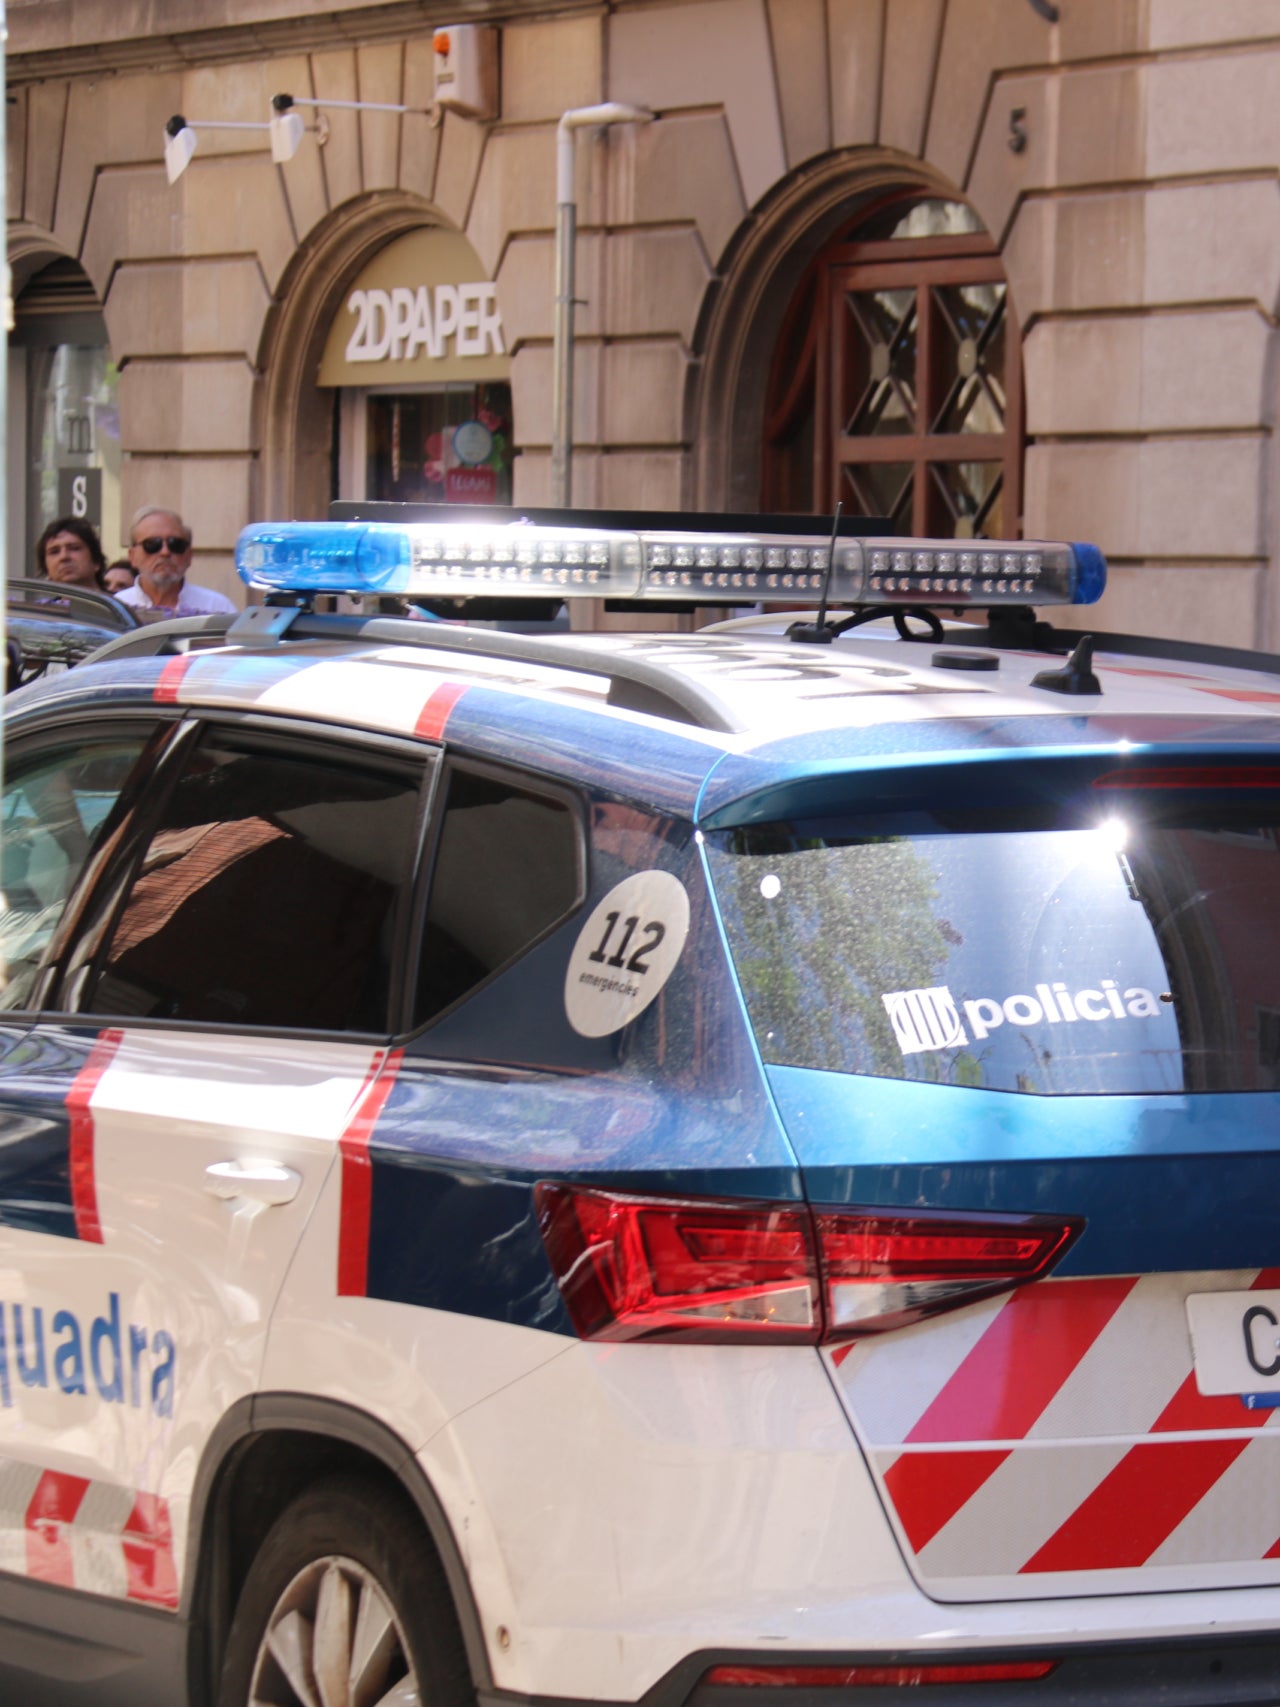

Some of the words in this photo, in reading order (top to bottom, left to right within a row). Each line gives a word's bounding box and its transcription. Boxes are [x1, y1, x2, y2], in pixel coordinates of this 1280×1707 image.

[1007, 107, 1027, 155] 5
[345, 281, 505, 362] 2DPAPER
[588, 911, 666, 975] 112
[962, 979, 1162, 1040] policia
